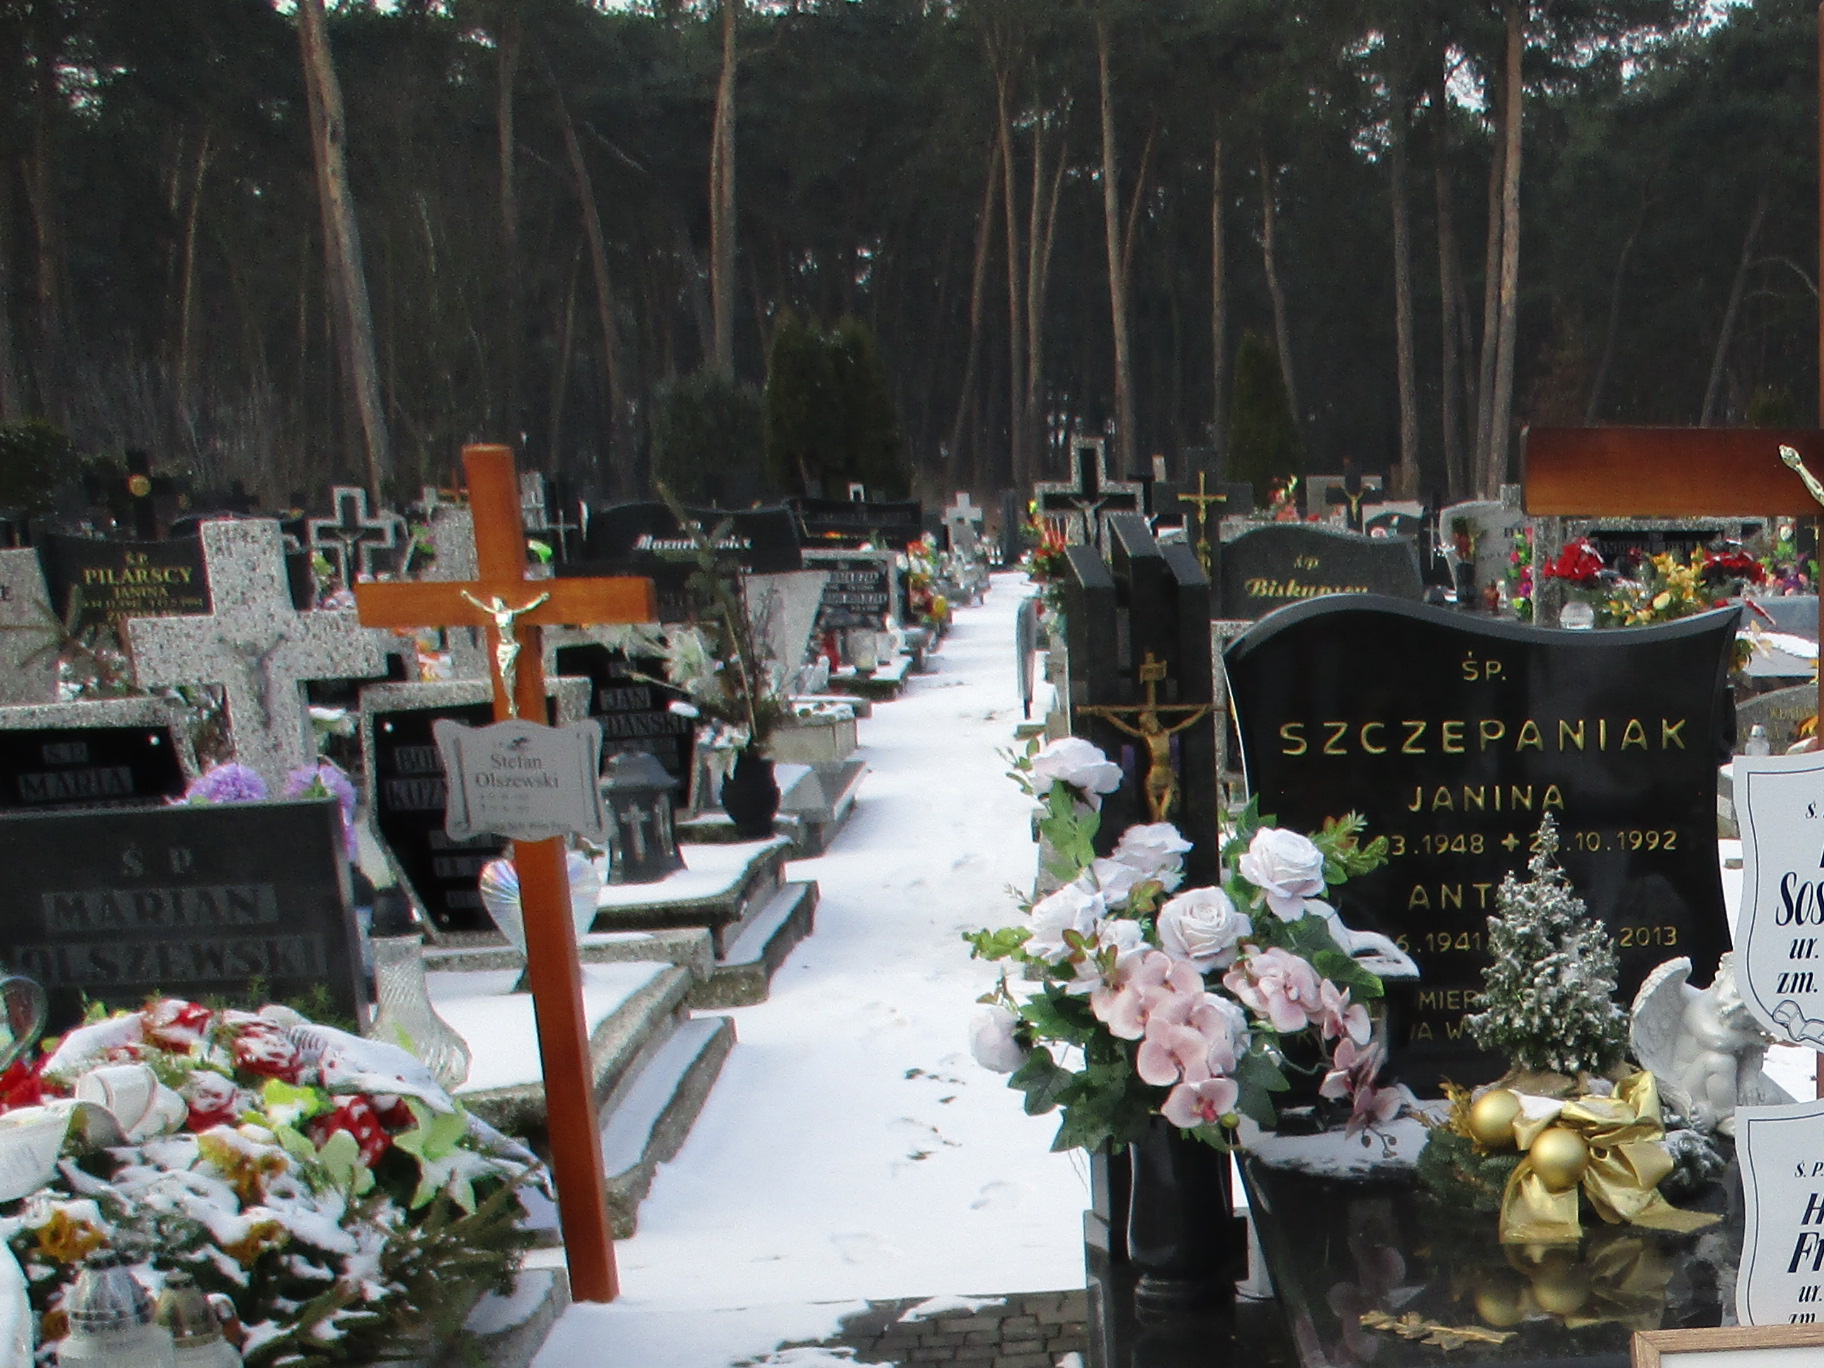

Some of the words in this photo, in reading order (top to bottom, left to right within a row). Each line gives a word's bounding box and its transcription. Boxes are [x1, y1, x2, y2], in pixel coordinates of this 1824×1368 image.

[83, 567, 192, 584] PILARSCY
[1280, 718, 1686, 755] SZCZEPANIAK
[475, 771, 559, 789] Olszewski
[1408, 784, 1565, 813] JANINA
[1789, 937, 1819, 960] ur.
[1776, 971, 1818, 994] zm.
[1798, 1284, 1823, 1304] ur.
